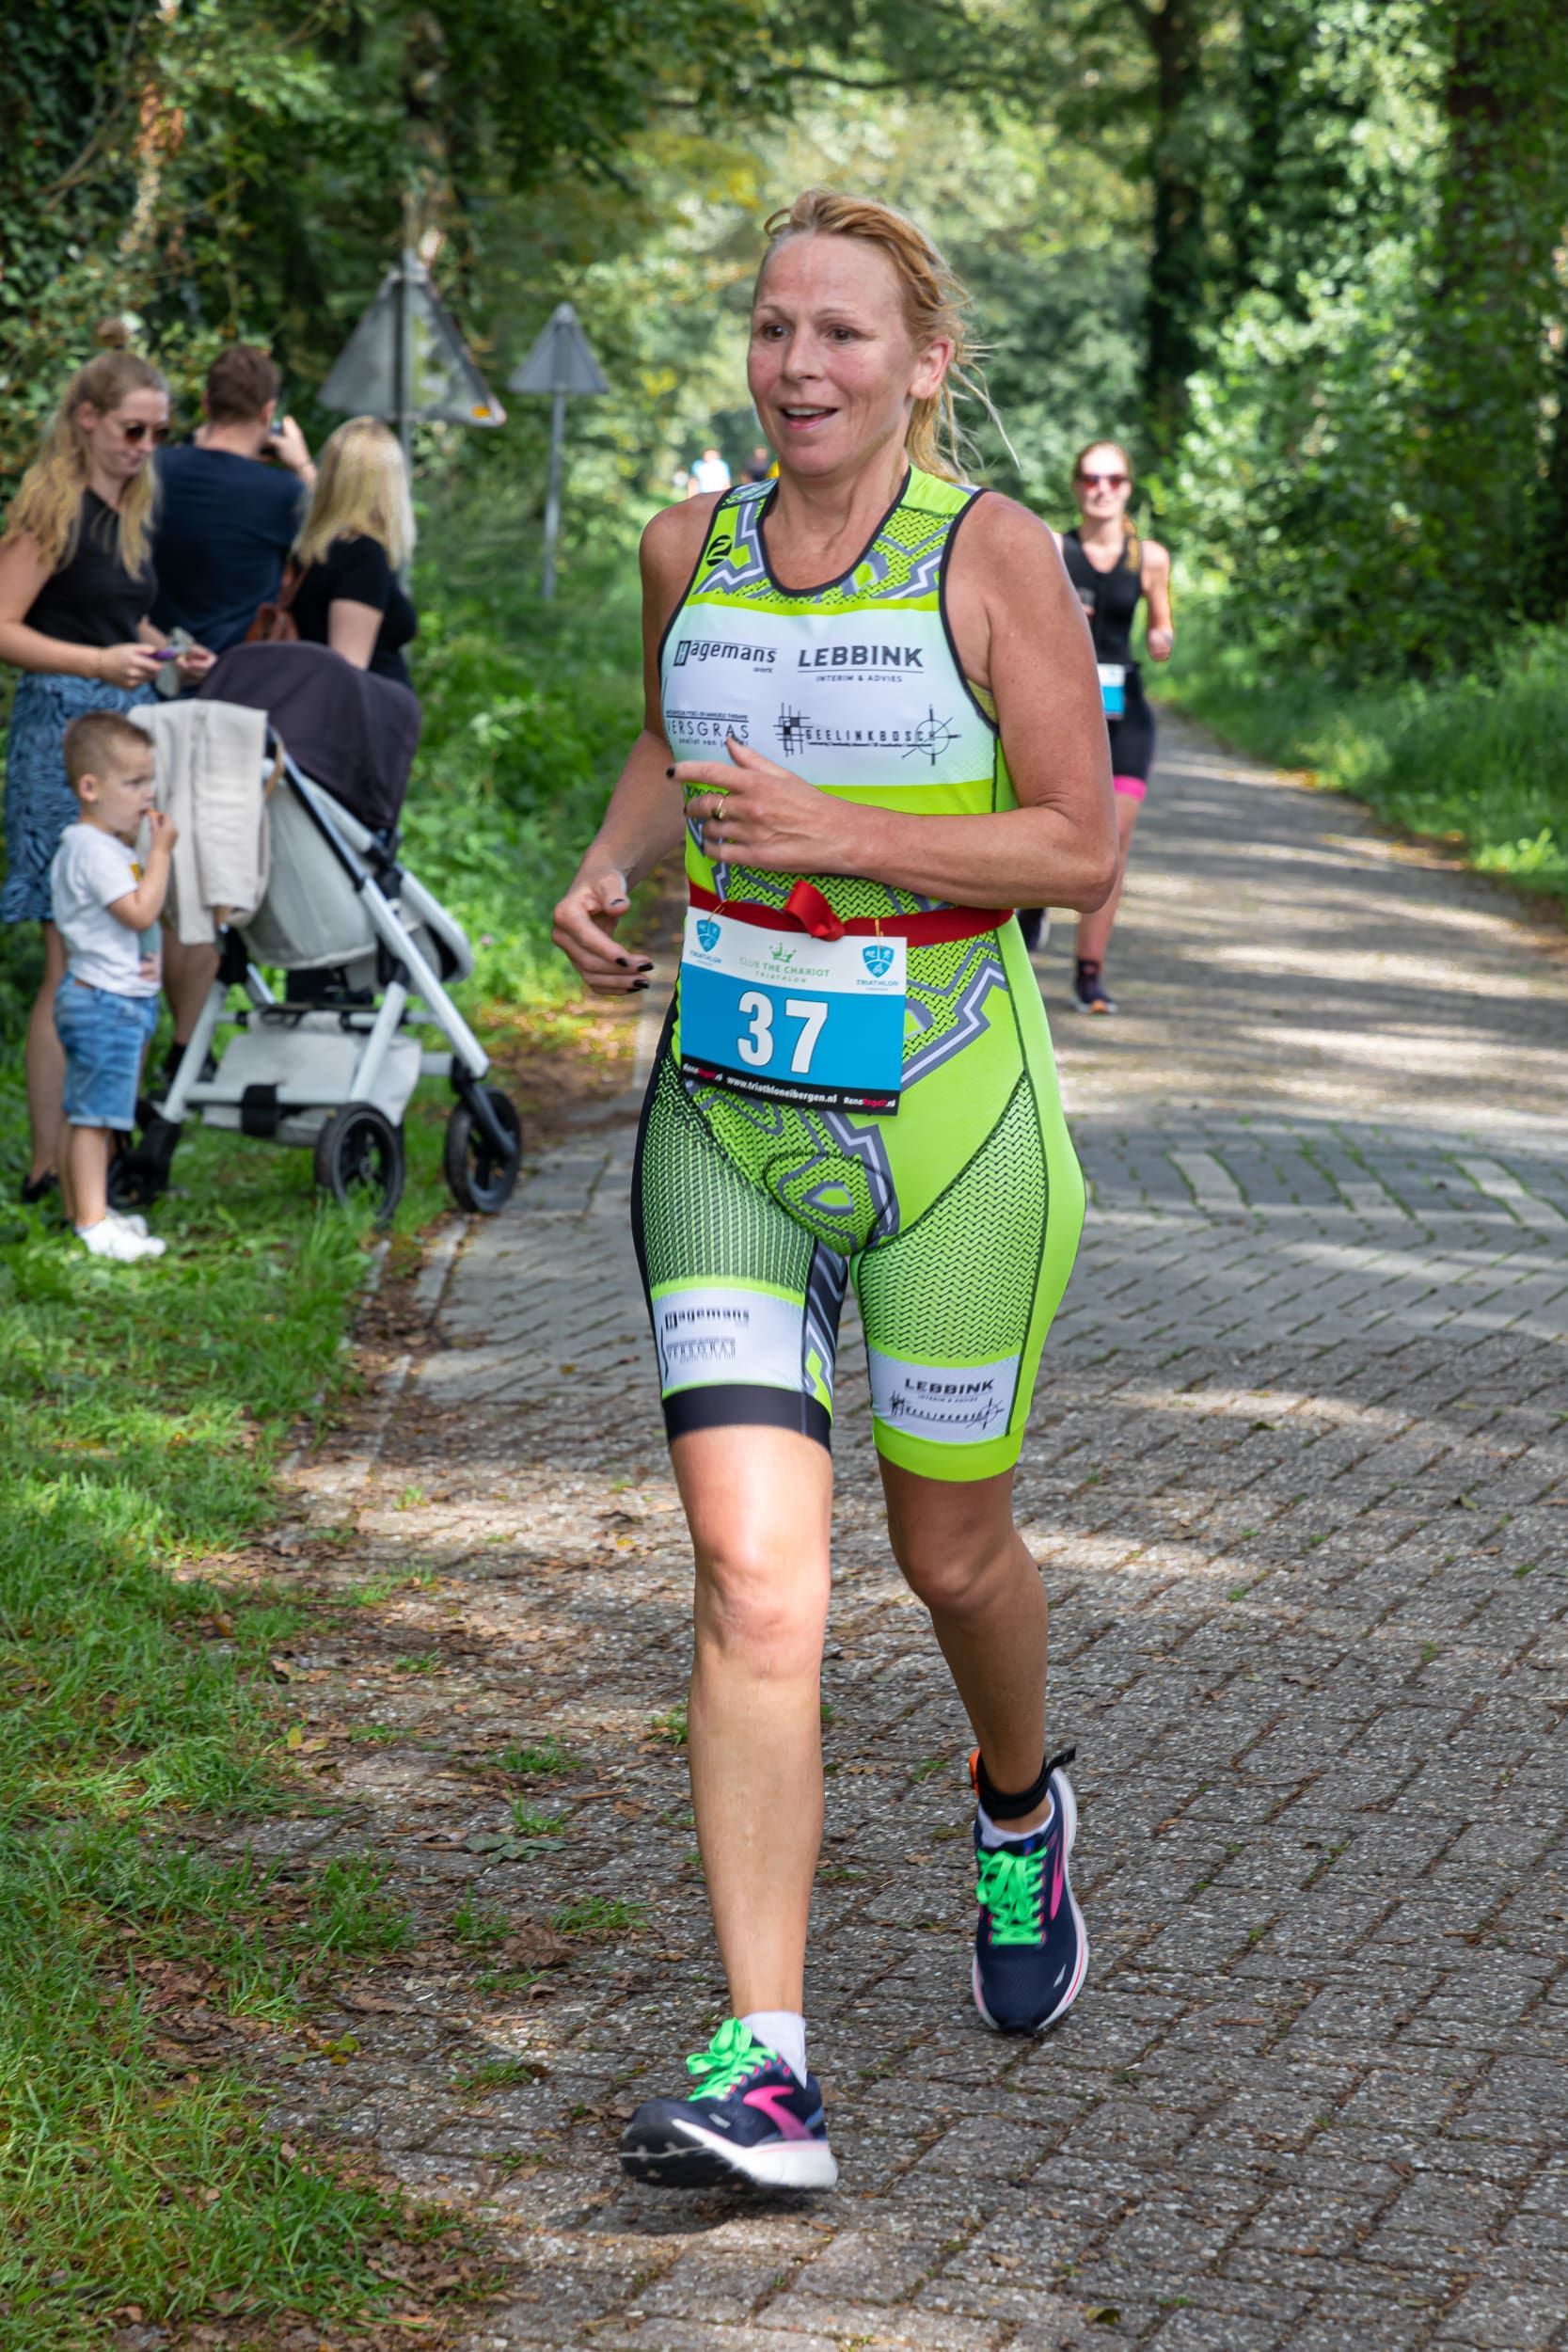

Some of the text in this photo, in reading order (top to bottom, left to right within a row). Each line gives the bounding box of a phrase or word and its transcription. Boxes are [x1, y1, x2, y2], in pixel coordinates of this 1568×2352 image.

[798, 644, 924, 668] LEBBINK
[763, 961, 781, 973] THE
[784, 965, 830, 977] CHARIOT
[737, 991, 829, 1074] 37
[726, 1075, 837, 1104] www.triathloneibergen.nl
[905, 1378, 994, 1395] LEBBINK
